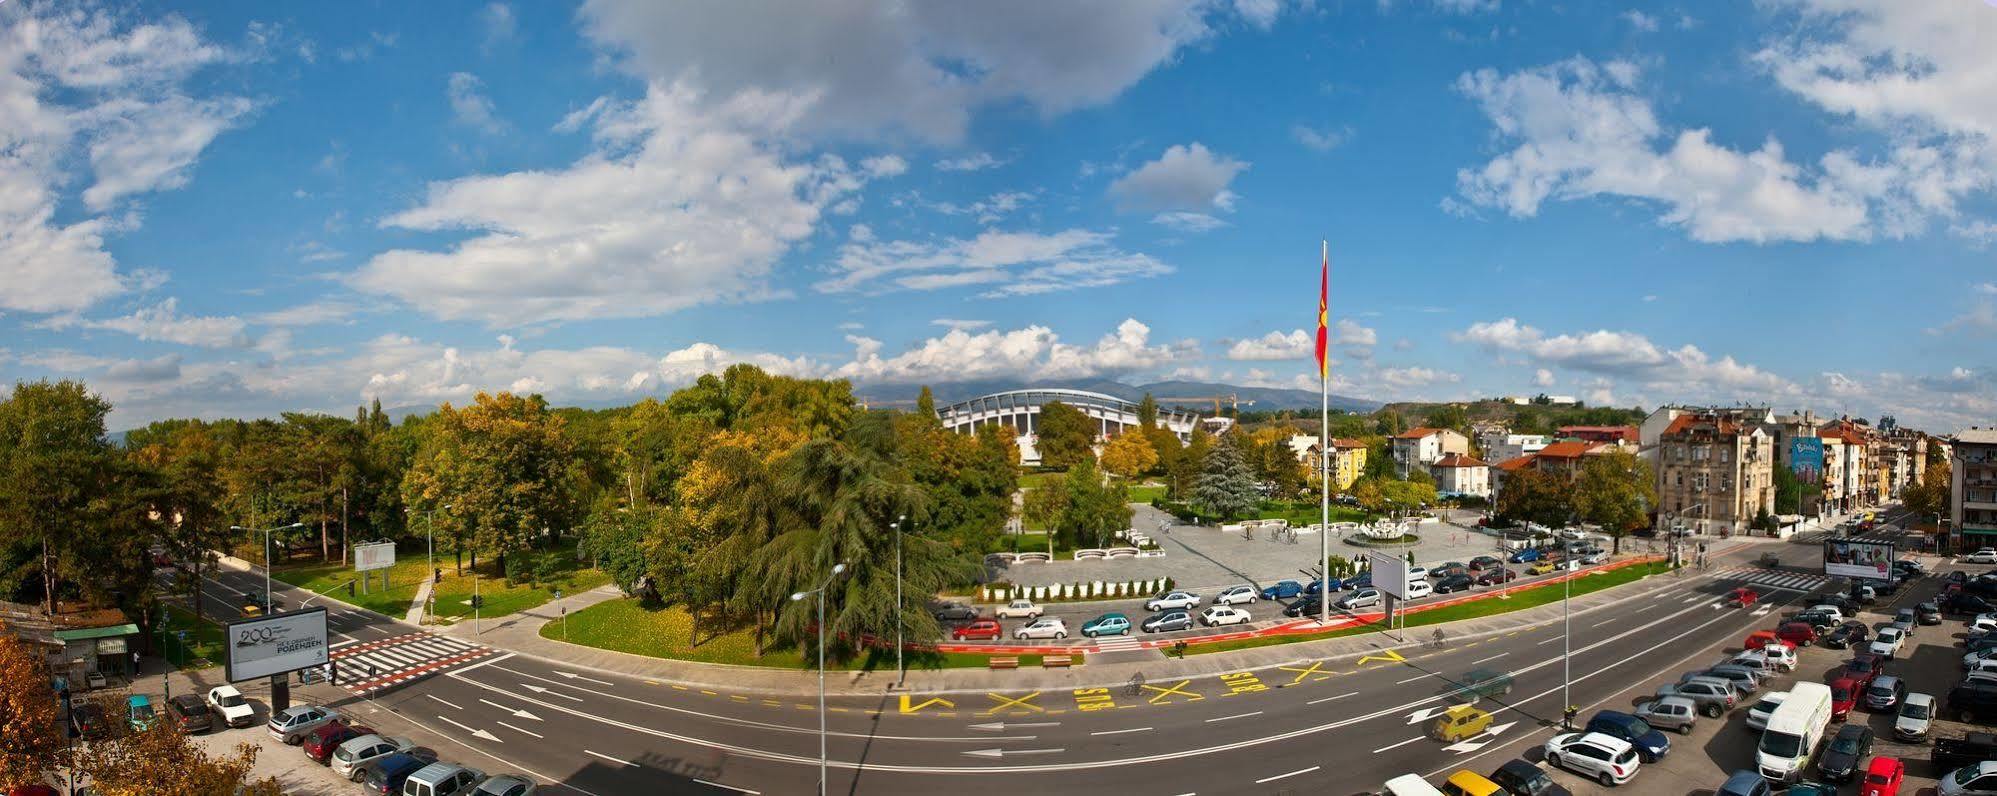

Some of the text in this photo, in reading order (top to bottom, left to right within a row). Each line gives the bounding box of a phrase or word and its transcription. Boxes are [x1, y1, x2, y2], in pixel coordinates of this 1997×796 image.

[240, 627, 272, 643] 200
[277, 639, 322, 653] РОДЕНДЕН
[1220, 672, 1266, 692] BUS
[1073, 688, 1115, 712] BUS
